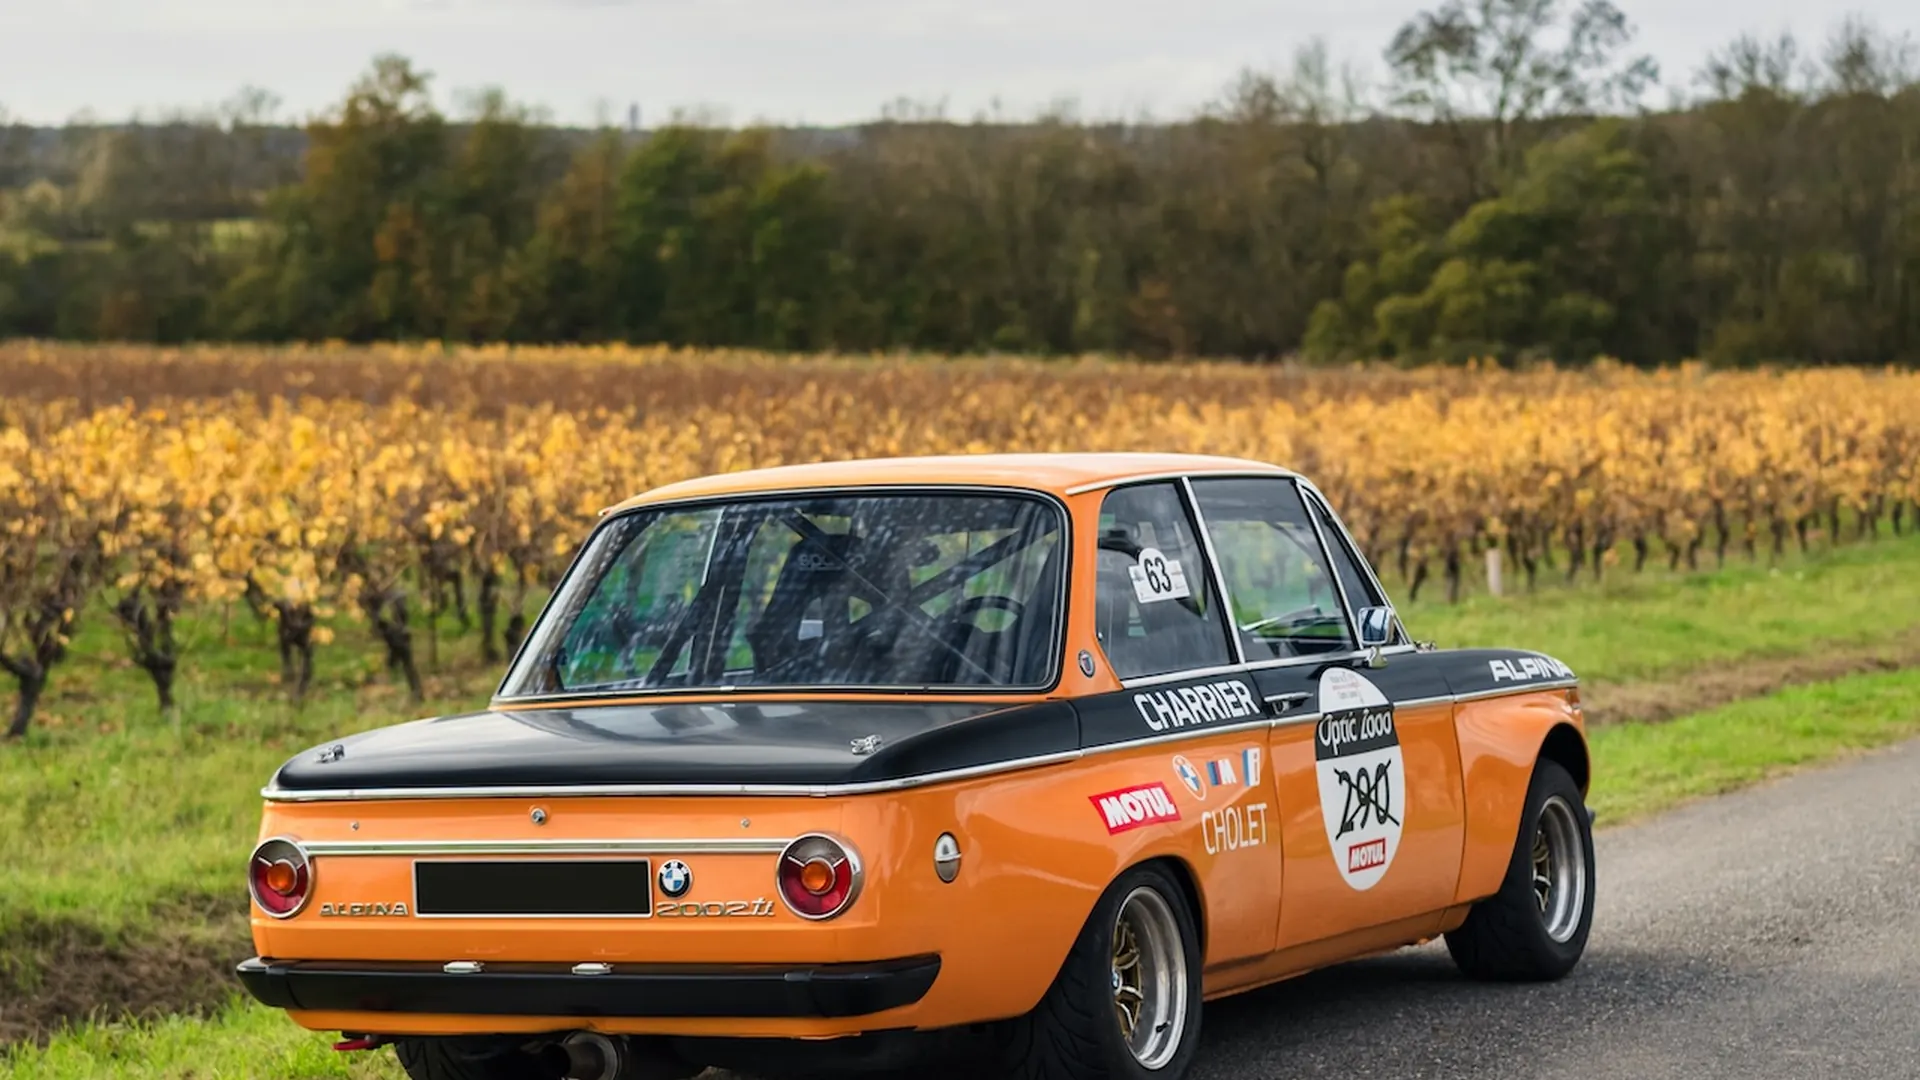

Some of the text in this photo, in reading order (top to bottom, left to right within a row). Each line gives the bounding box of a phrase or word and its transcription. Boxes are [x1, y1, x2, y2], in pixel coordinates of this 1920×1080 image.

[1144, 557, 1172, 593] 63
[1488, 657, 1576, 682] ALPINA
[1134, 680, 1260, 731] CHARRIER
[1319, 708, 1392, 756] Optic 2000
[1099, 786, 1177, 829] MOTUL
[1338, 763, 1390, 834] 290
[1201, 803, 1268, 855] CHOLET
[1349, 842, 1385, 870] MOTUL
[320, 902, 409, 917] ALPINA
